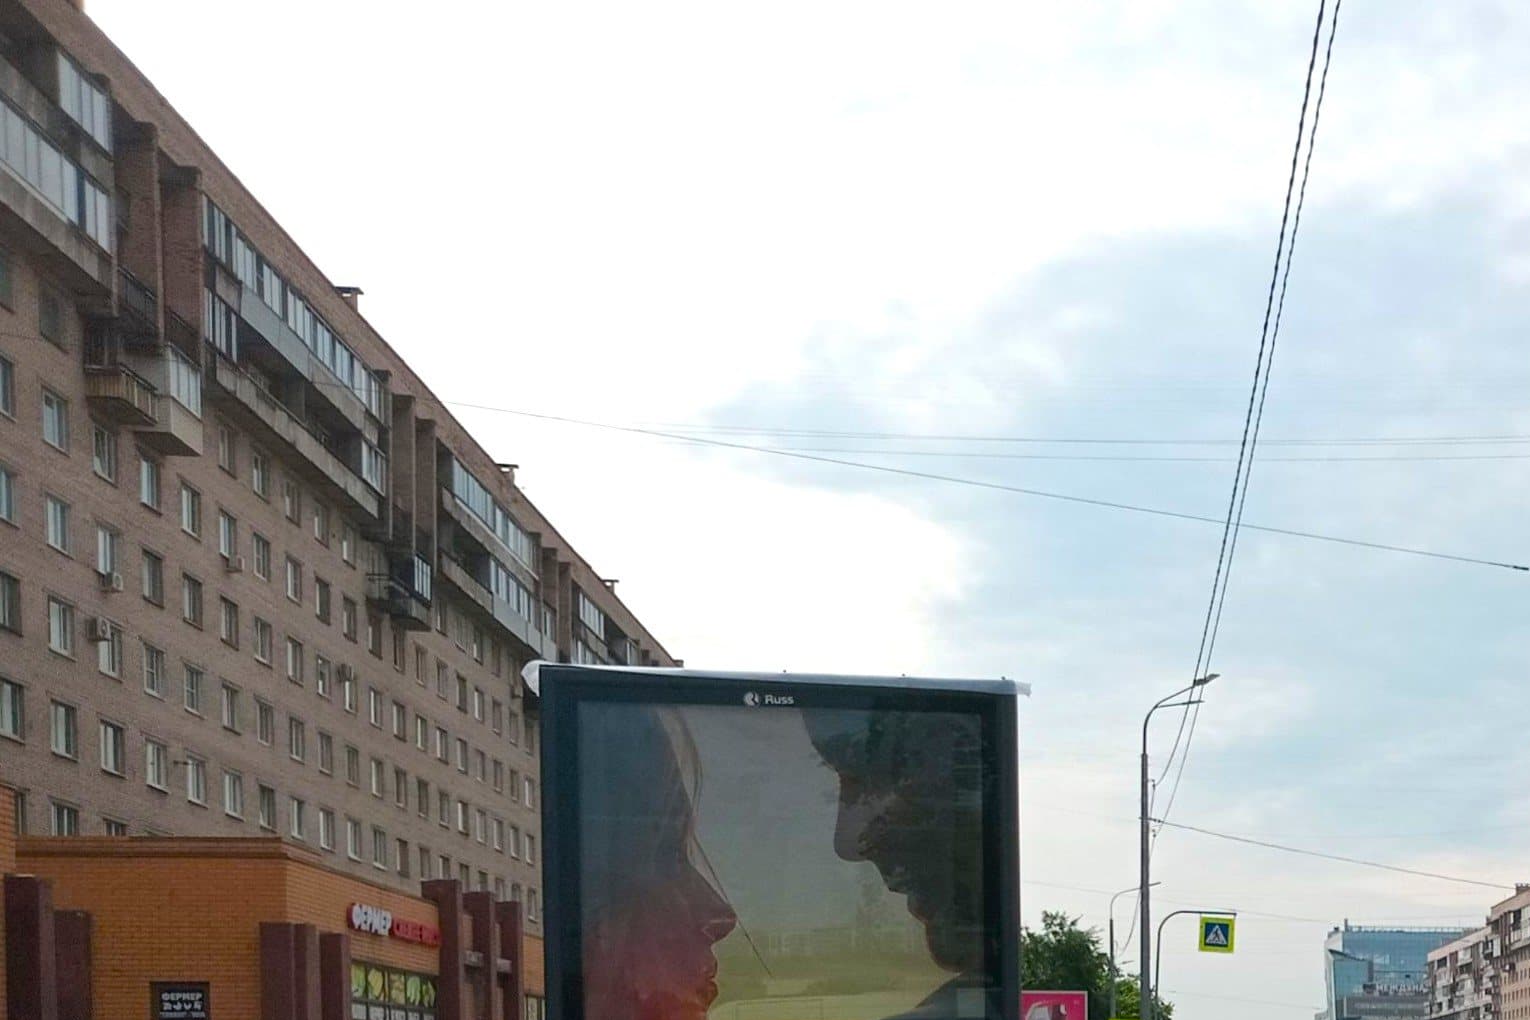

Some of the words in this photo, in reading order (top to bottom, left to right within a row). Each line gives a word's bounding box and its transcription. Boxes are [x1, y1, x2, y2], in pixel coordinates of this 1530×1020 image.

[764, 694, 795, 705] Russ
[352, 903, 392, 936] ФЕРМЕР
[161, 991, 203, 1001] ФЕРМЕР
